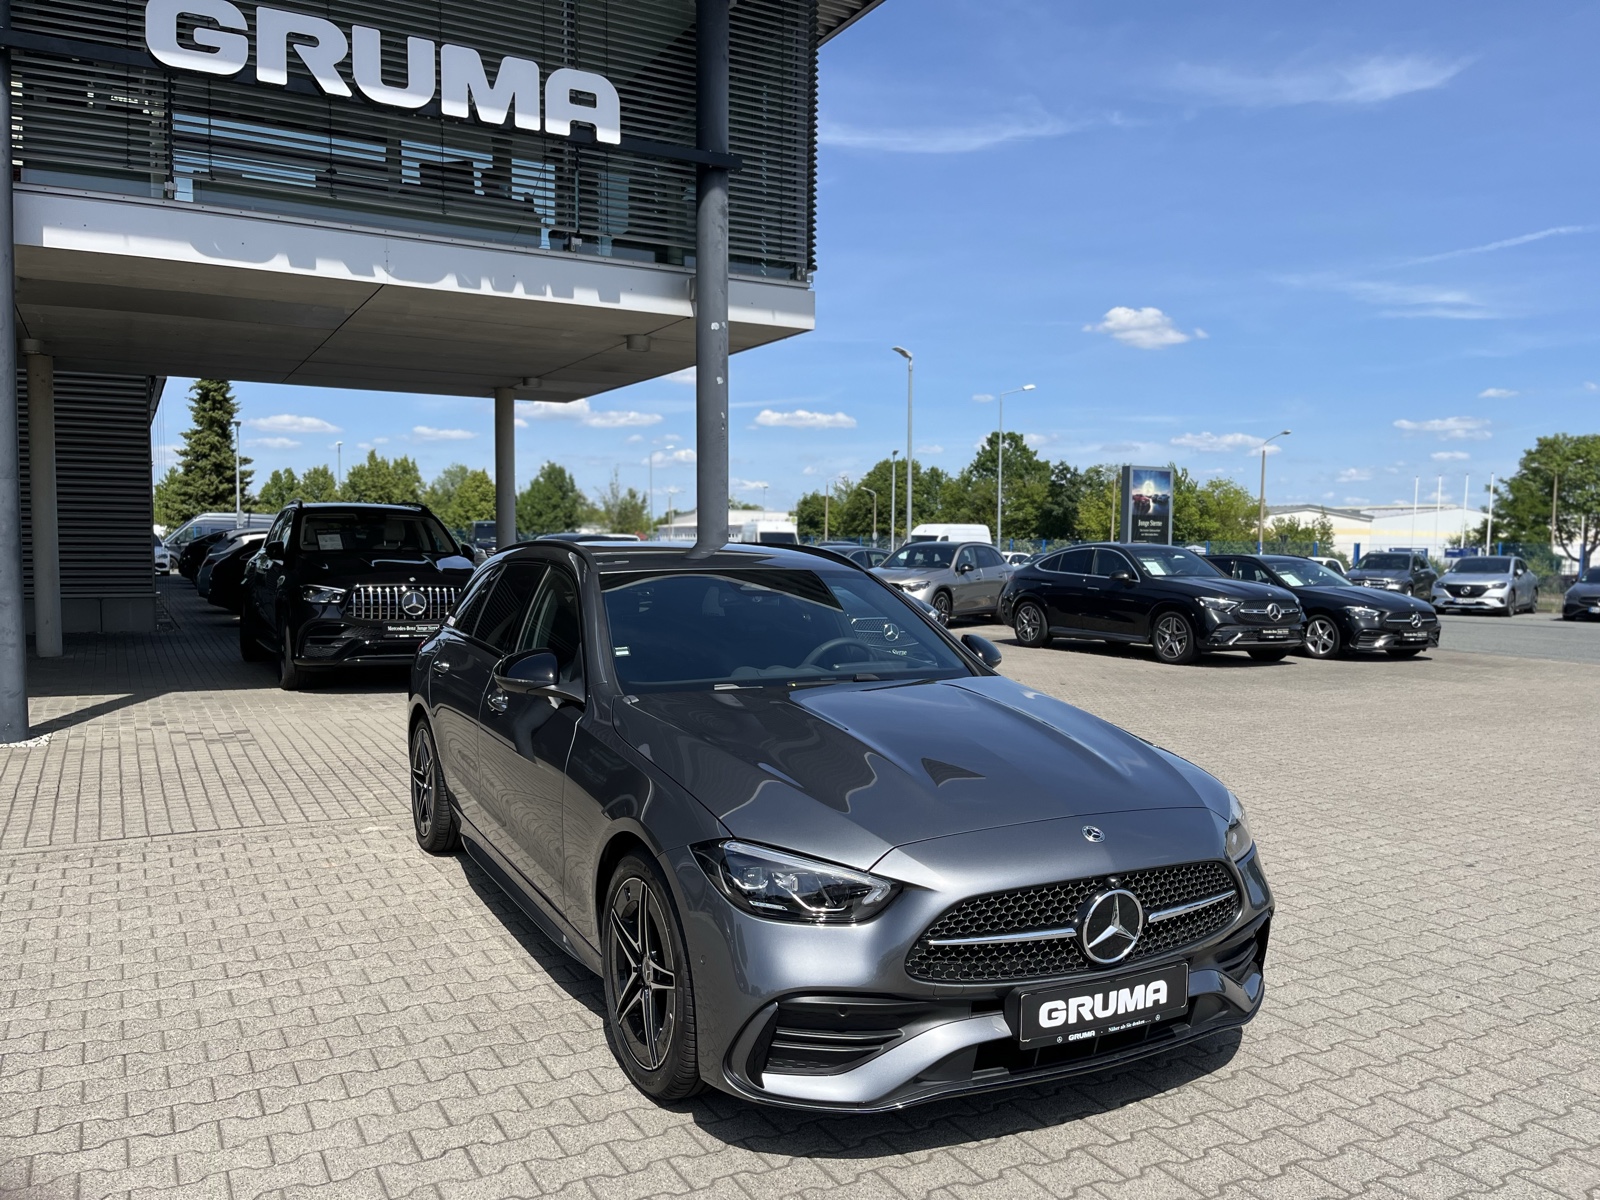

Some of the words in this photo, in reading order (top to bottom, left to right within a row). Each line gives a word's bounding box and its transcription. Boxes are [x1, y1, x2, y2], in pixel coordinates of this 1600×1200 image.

[145, 0, 621, 145] GRUMA
[1039, 979, 1168, 1029] GRUMA
[1068, 1030, 1095, 1041] GRUMA
